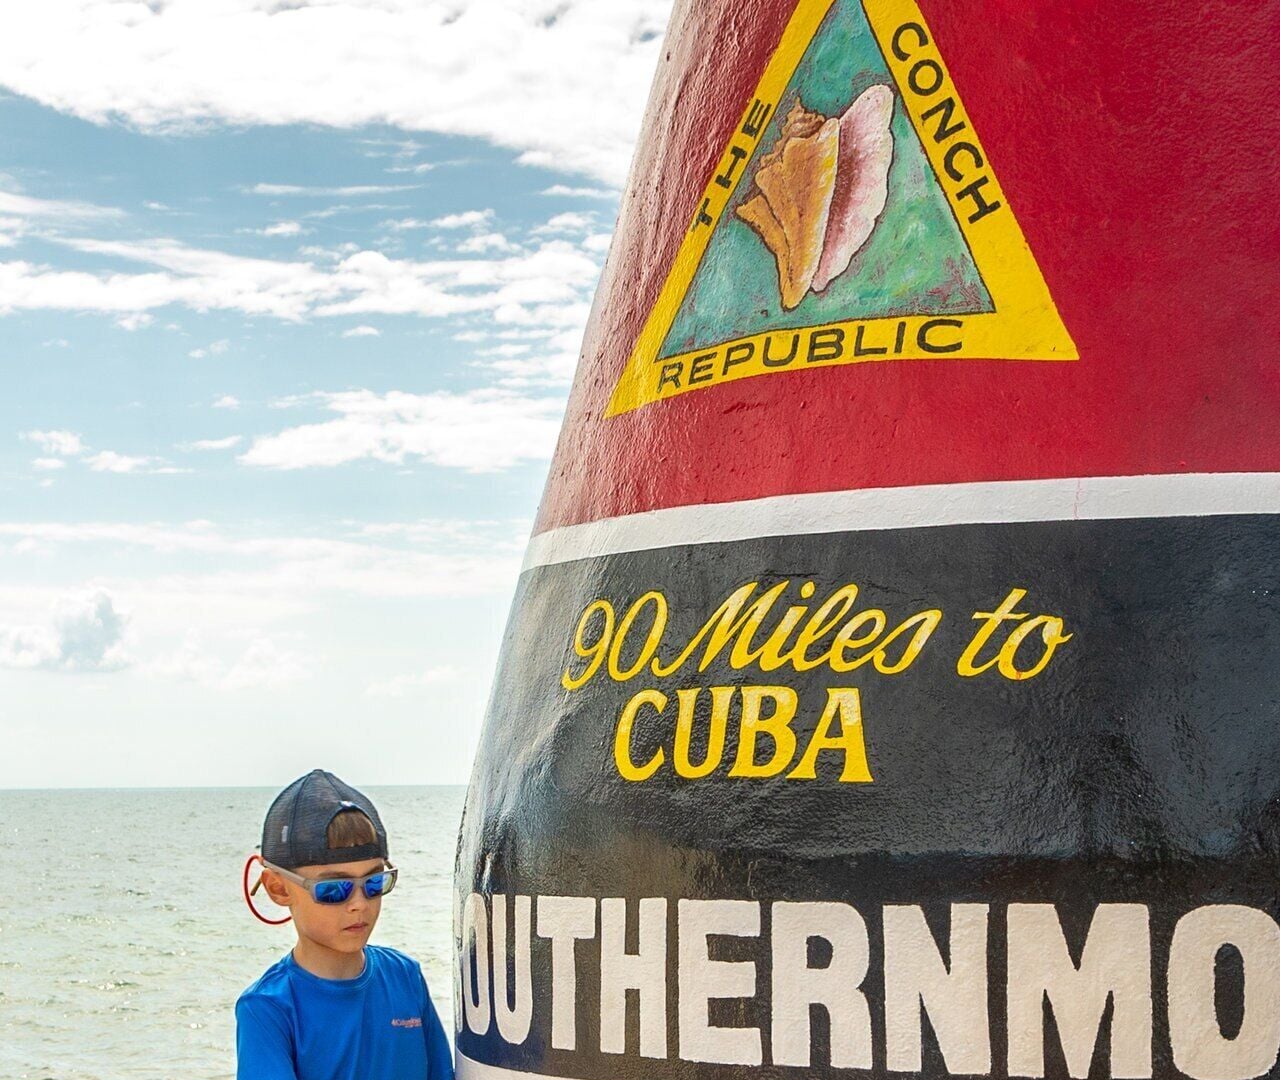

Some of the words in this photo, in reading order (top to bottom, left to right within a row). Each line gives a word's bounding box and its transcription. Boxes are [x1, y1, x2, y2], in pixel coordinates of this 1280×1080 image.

[691, 99, 771, 232] THE
[892, 22, 1001, 225] CONCH
[656, 319, 964, 394] REPUBLIC
[561, 591, 668, 691] 90
[651, 580, 943, 677] Miles
[957, 588, 1074, 680] to
[614, 685, 873, 783] CUBA
